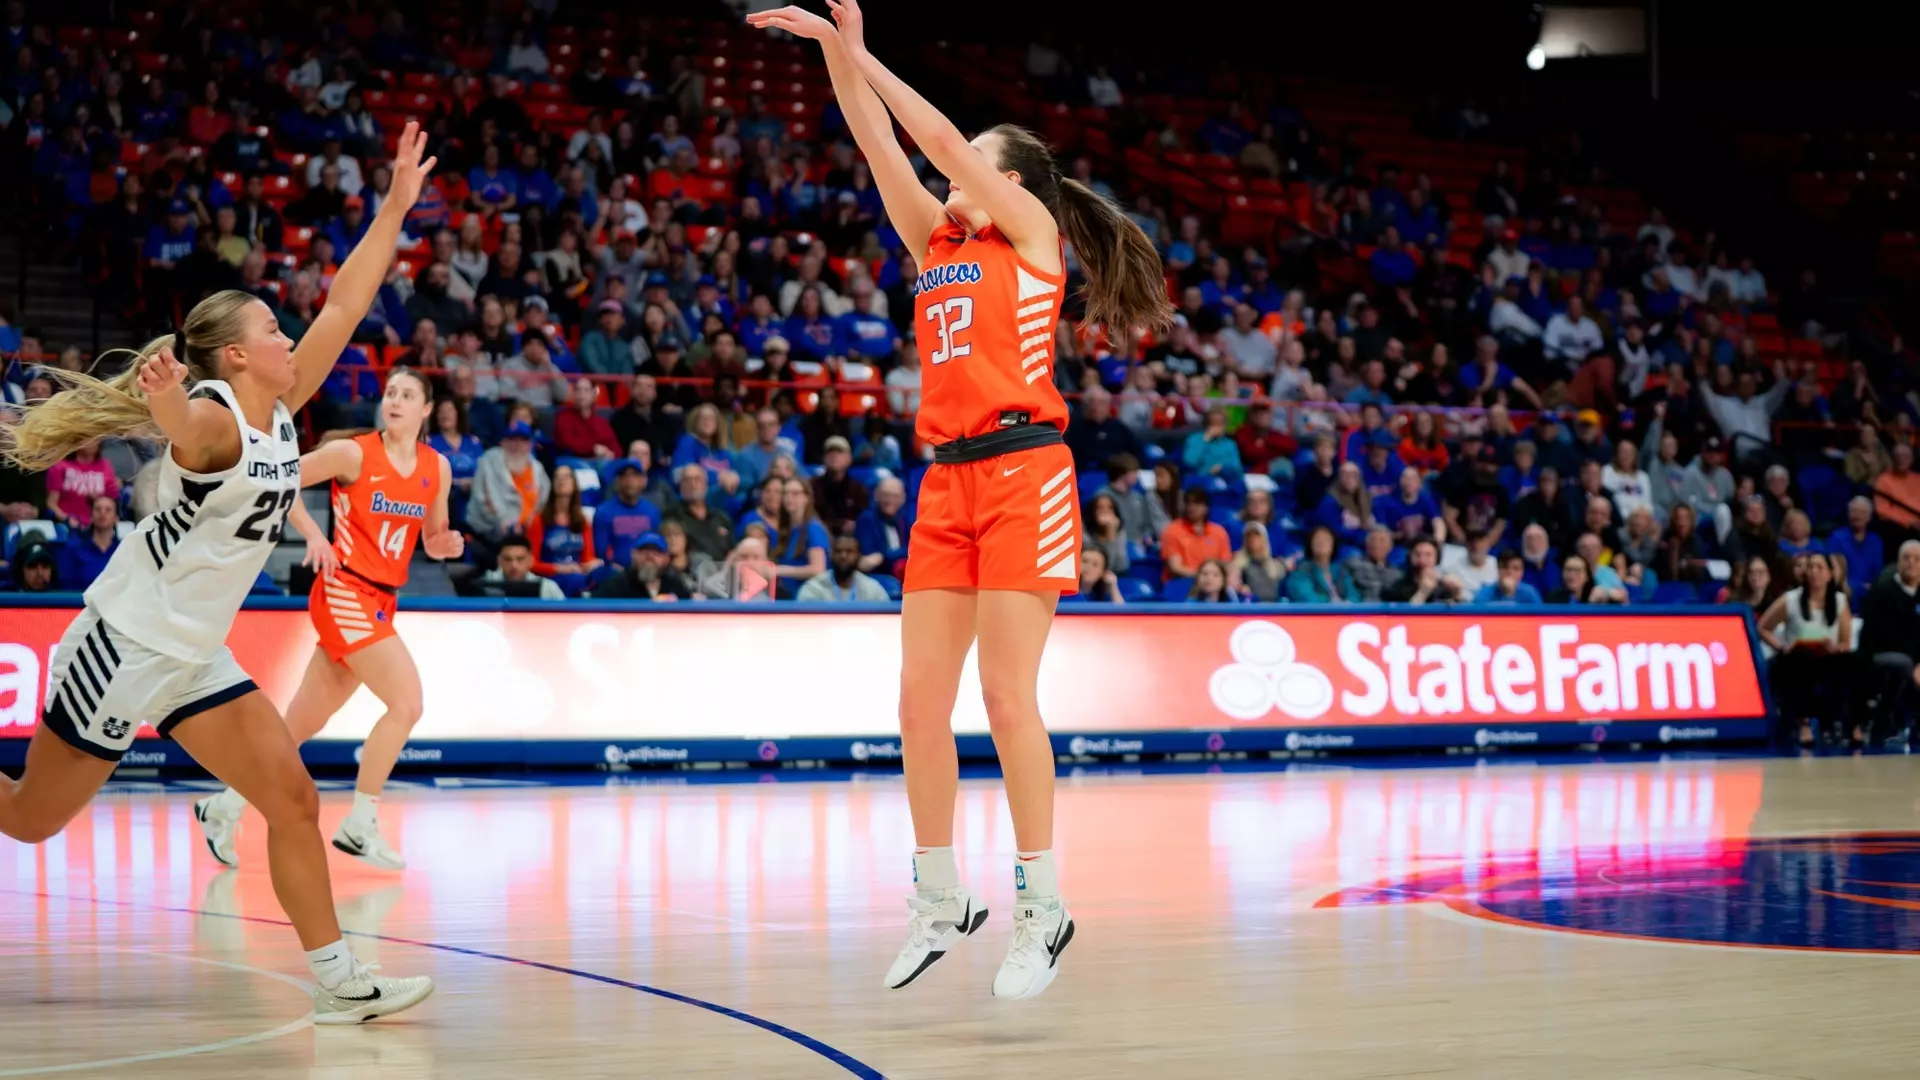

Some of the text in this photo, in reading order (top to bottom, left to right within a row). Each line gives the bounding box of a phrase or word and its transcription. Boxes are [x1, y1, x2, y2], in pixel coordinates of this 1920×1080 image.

[912, 262, 982, 298] roncos
[926, 296, 974, 365] 32
[247, 461, 279, 480] UTAH
[233, 488, 297, 543] 23
[370, 490, 427, 520] Bronco
[378, 520, 410, 561] 14
[121, 750, 167, 765] icSource
[398, 748, 443, 761] icSource
